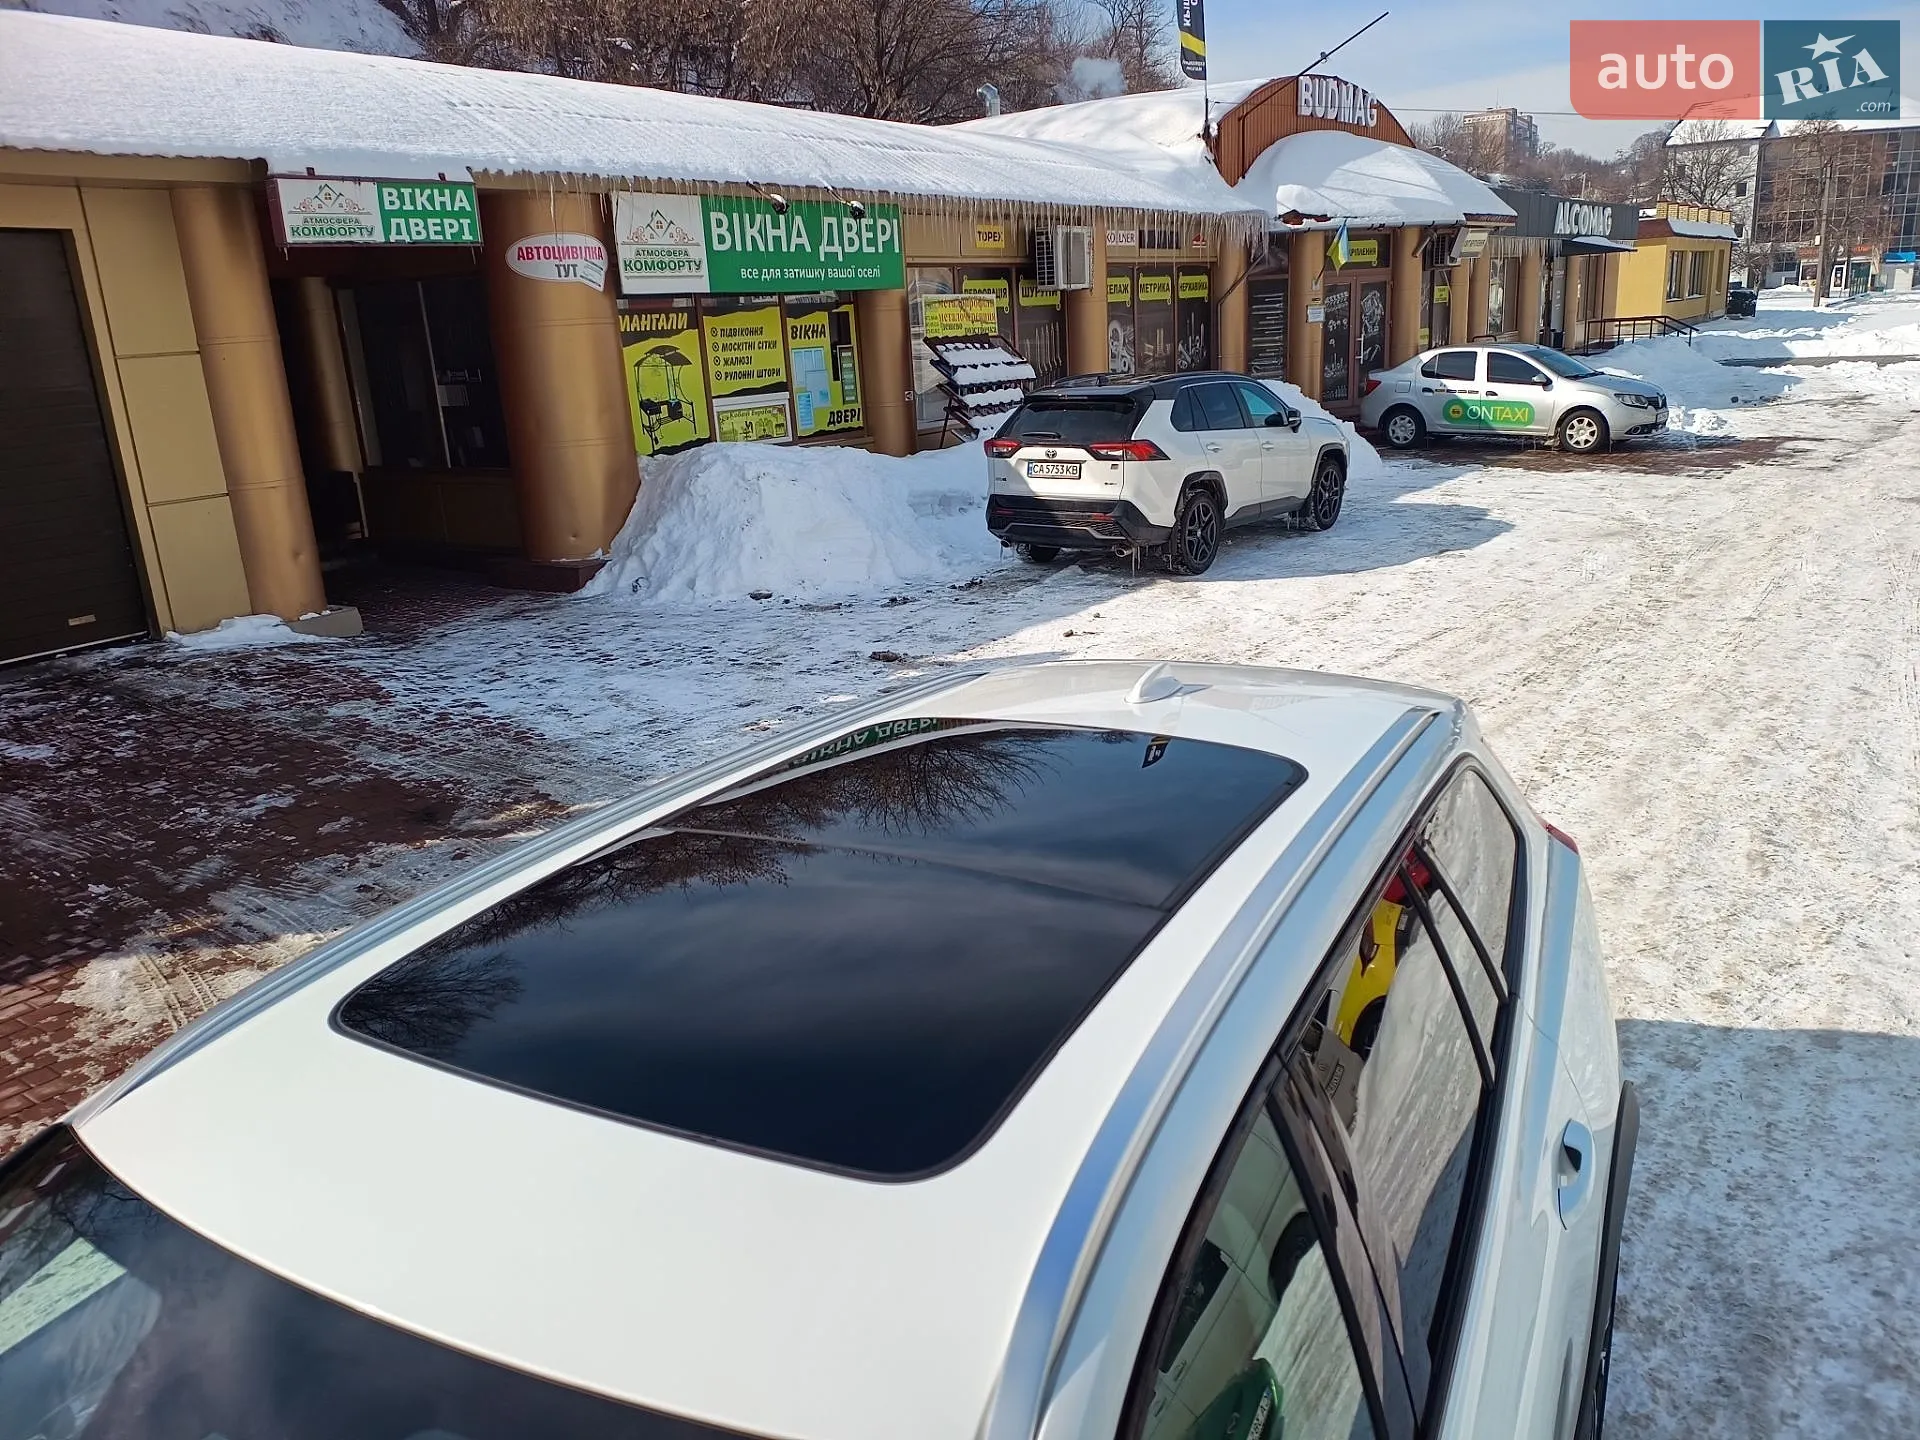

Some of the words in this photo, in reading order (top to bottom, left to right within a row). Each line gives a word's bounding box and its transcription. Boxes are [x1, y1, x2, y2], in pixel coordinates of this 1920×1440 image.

[1298, 75, 1377, 127] BUDMAG
[383, 187, 471, 211] ВІКНА
[303, 216, 360, 225] АТМОСФЕРА
[1554, 201, 1612, 236] ALCOMAG
[291, 226, 374, 237] КОМФОРТУ
[389, 217, 473, 242] ДВЕРІ
[710, 211, 812, 253] ВІКНА
[819, 216, 899, 262] ДВЕРІ
[517, 246, 604, 262] АВТОЦИВІЛКА
[635, 250, 689, 258] АТМОСФЕРА
[555, 264, 578, 278] ТУТ
[624, 259, 702, 273] КОМФОРТУ
[740, 267, 760, 279] все
[762, 268, 782, 281] для
[784, 267, 826, 281] затишку
[828, 266, 856, 278] вашої
[858, 265, 881, 278] оселі
[1140, 282, 1170, 294] МЕТРИКА
[719, 327, 764, 338] ПІДВІКОННЯ
[790, 323, 826, 340] ВІКНА
[721, 343, 756, 353] МОСКІТНІ
[757, 340, 778, 350] СІТКИ
[722, 356, 752, 367] ЖАЛЮЗІ
[724, 370, 755, 381] РУЛОННІ
[756, 368, 781, 378] ШТОРИ
[827, 408, 861, 427] ДВЕРІ
[1467, 405, 1529, 422] ONTAXI
[1046, 464, 1065, 475] 5753
